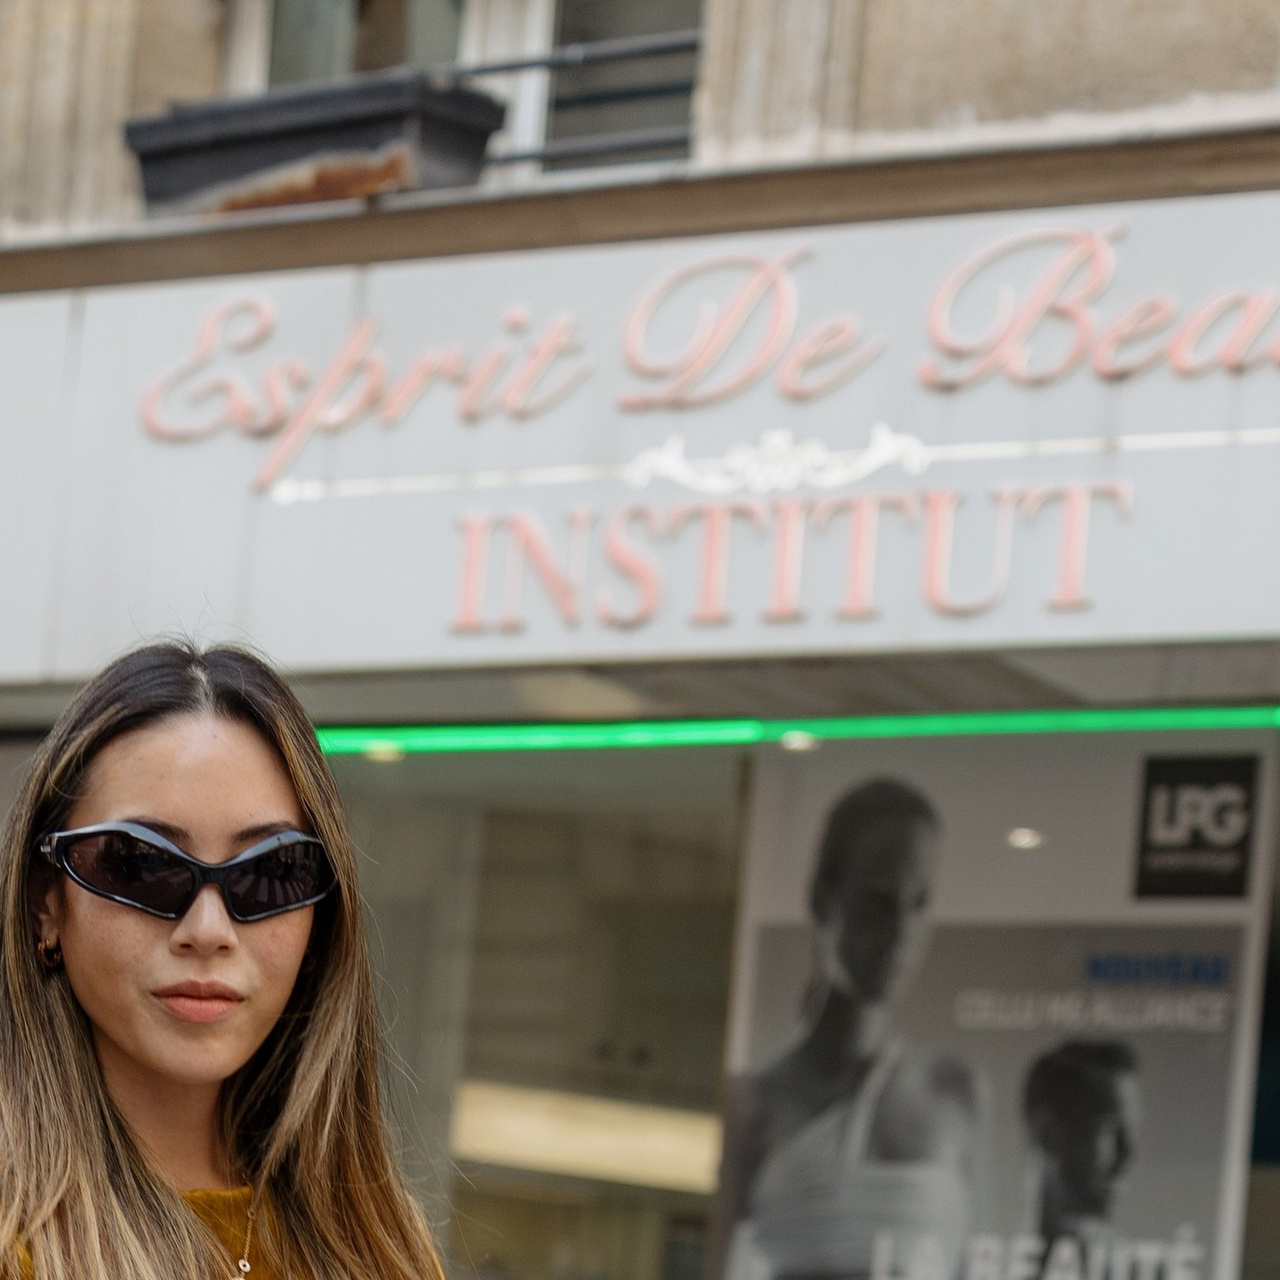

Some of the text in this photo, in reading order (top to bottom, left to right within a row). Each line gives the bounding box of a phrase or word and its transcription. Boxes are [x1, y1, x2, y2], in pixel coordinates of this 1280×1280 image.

[141, 224, 1280, 493] Esprit De Bea
[450, 484, 1132, 636] INSTITUT
[1150, 784, 1248, 844] LPG
